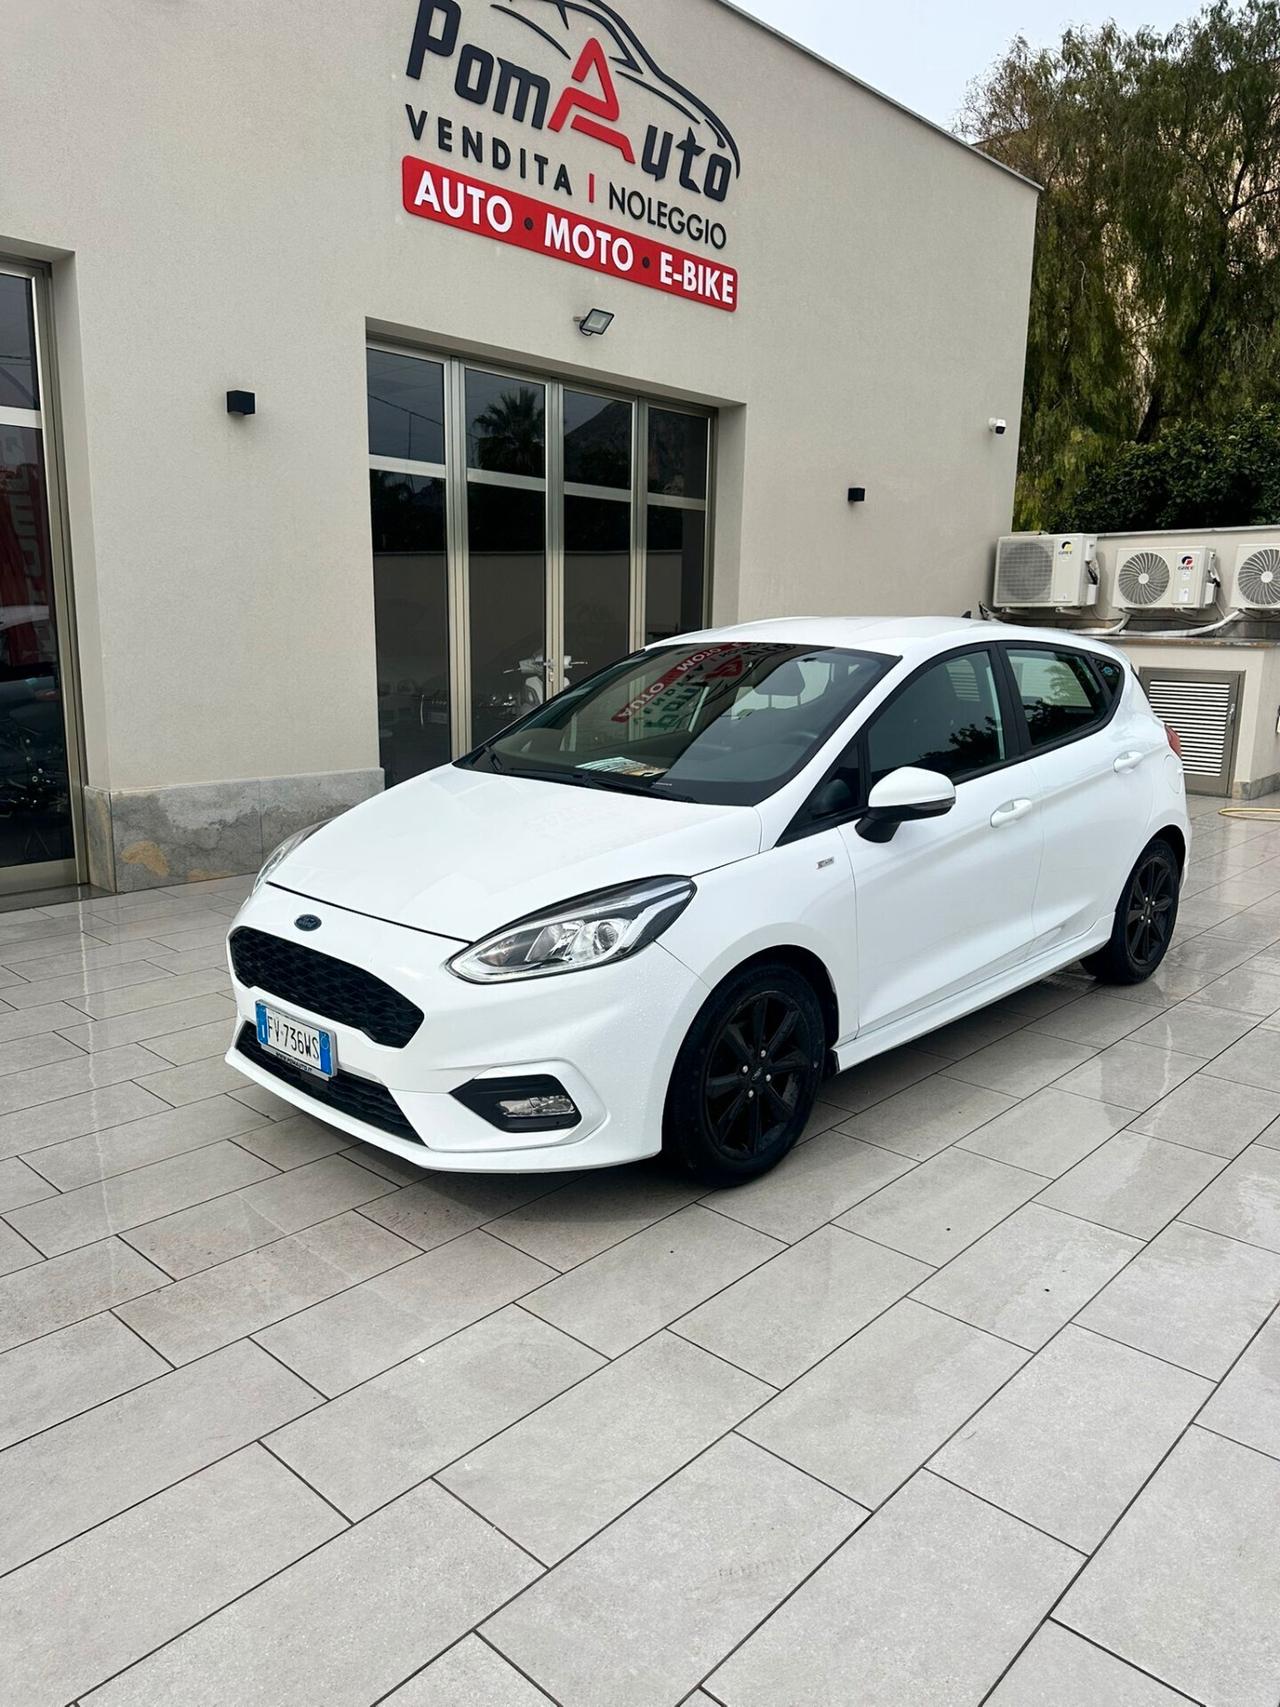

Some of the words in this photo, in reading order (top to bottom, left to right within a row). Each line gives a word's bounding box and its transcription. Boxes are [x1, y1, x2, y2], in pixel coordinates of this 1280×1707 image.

[405, 104, 572, 196] VENDITA
[609, 182, 727, 250] NOLEGGIO
[413, 170, 513, 233] AUTO
[544, 213, 634, 272] MOTO
[659, 251, 734, 304] E-BIKE
